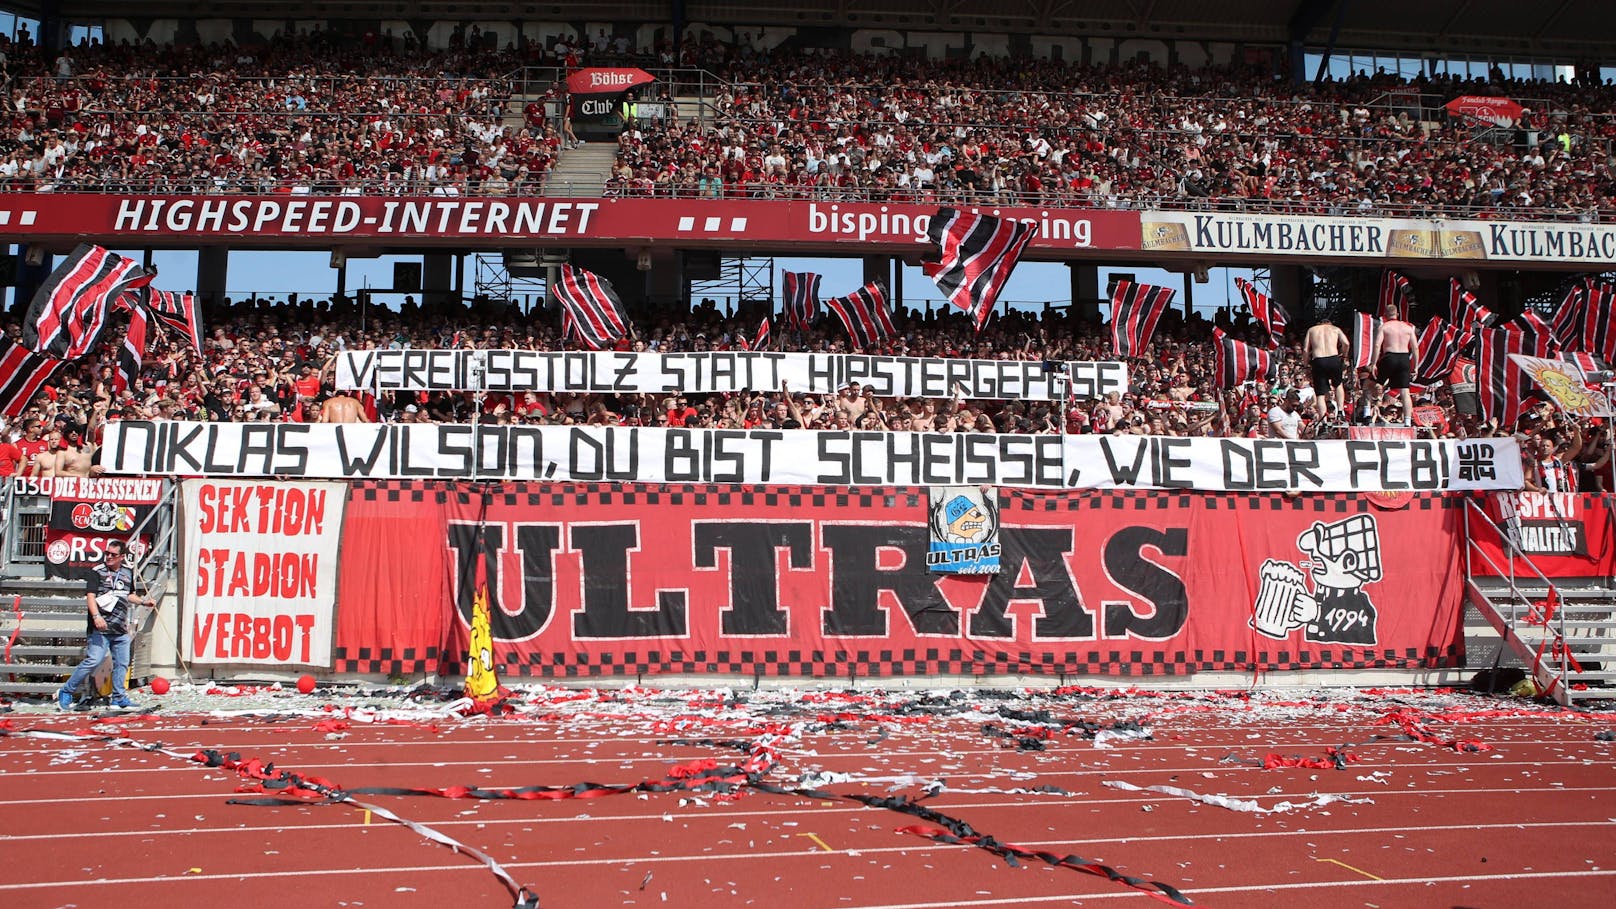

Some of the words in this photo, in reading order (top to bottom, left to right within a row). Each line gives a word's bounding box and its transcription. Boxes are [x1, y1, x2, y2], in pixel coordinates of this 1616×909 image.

[590, 71, 634, 88] Böhse
[581, 99, 614, 115] Club
[114, 199, 599, 234] HIGHSPEED-INTERNET
[809, 203, 931, 244] bisping
[1194, 215, 1384, 254] KULMBACHER
[348, 350, 638, 392] VEREINSSTOLZ
[660, 351, 786, 394] STATT
[115, 421, 311, 476] NIKLAS
[664, 428, 786, 482] BIST
[817, 430, 1081, 487] SCHEISSE,
[1099, 435, 1194, 489] WIE
[1219, 439, 1323, 490] DER
[1345, 440, 1450, 490] FCB!
[53, 475, 77, 498] DIE
[77, 477, 162, 501] BESESSENEN
[1496, 491, 1577, 519] RESPEKT
[198, 483, 326, 537] SEKTION
[926, 543, 1002, 566] ULTRAS
[957, 564, 977, 575] seit
[196, 547, 319, 600] STADION
[447, 518, 1190, 643] ULTRAS
[193, 612, 316, 664] VERBOT
[1324, 607, 1369, 632] 1994
